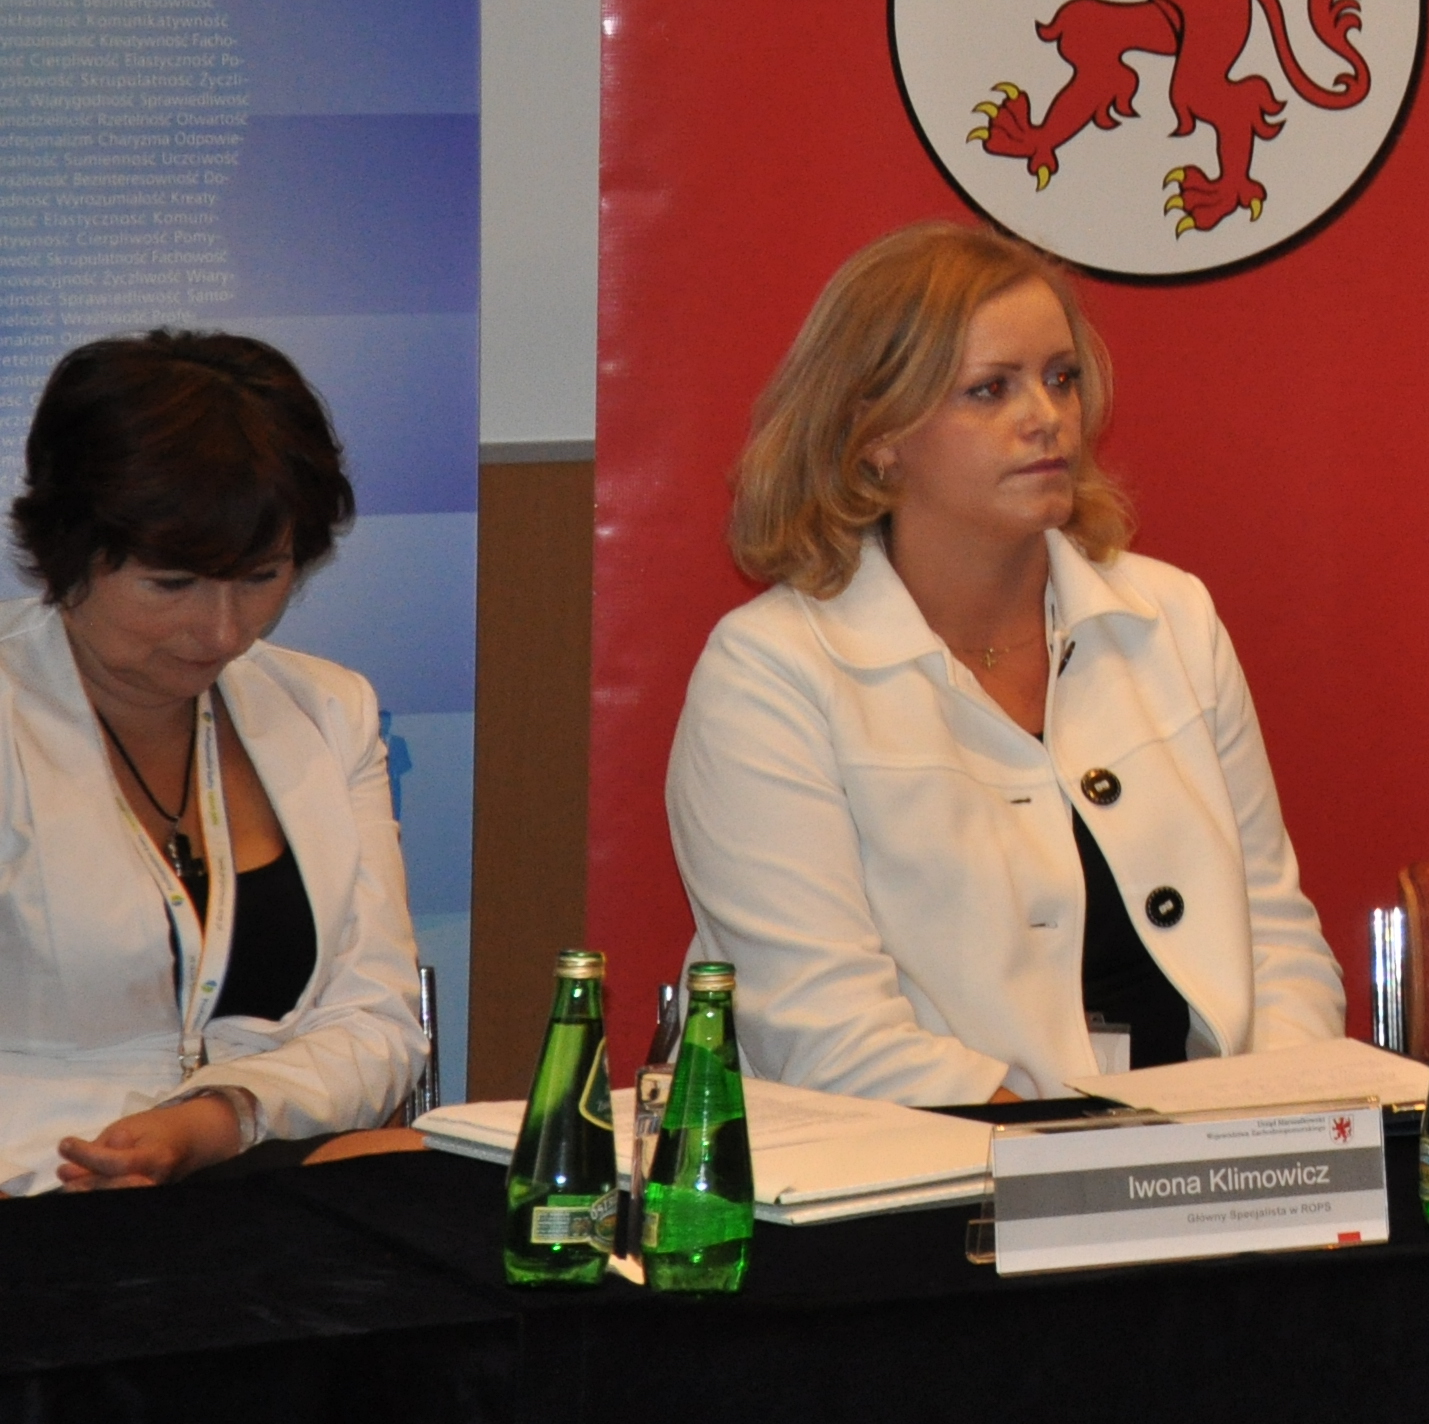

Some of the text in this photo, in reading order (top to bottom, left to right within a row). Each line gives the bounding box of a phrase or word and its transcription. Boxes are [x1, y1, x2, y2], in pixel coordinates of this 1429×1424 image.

[1128, 1160, 1332, 1200] Iwona Klimowicz
[1186, 1200, 1333, 1226] Główny Specjalista w ROPS
